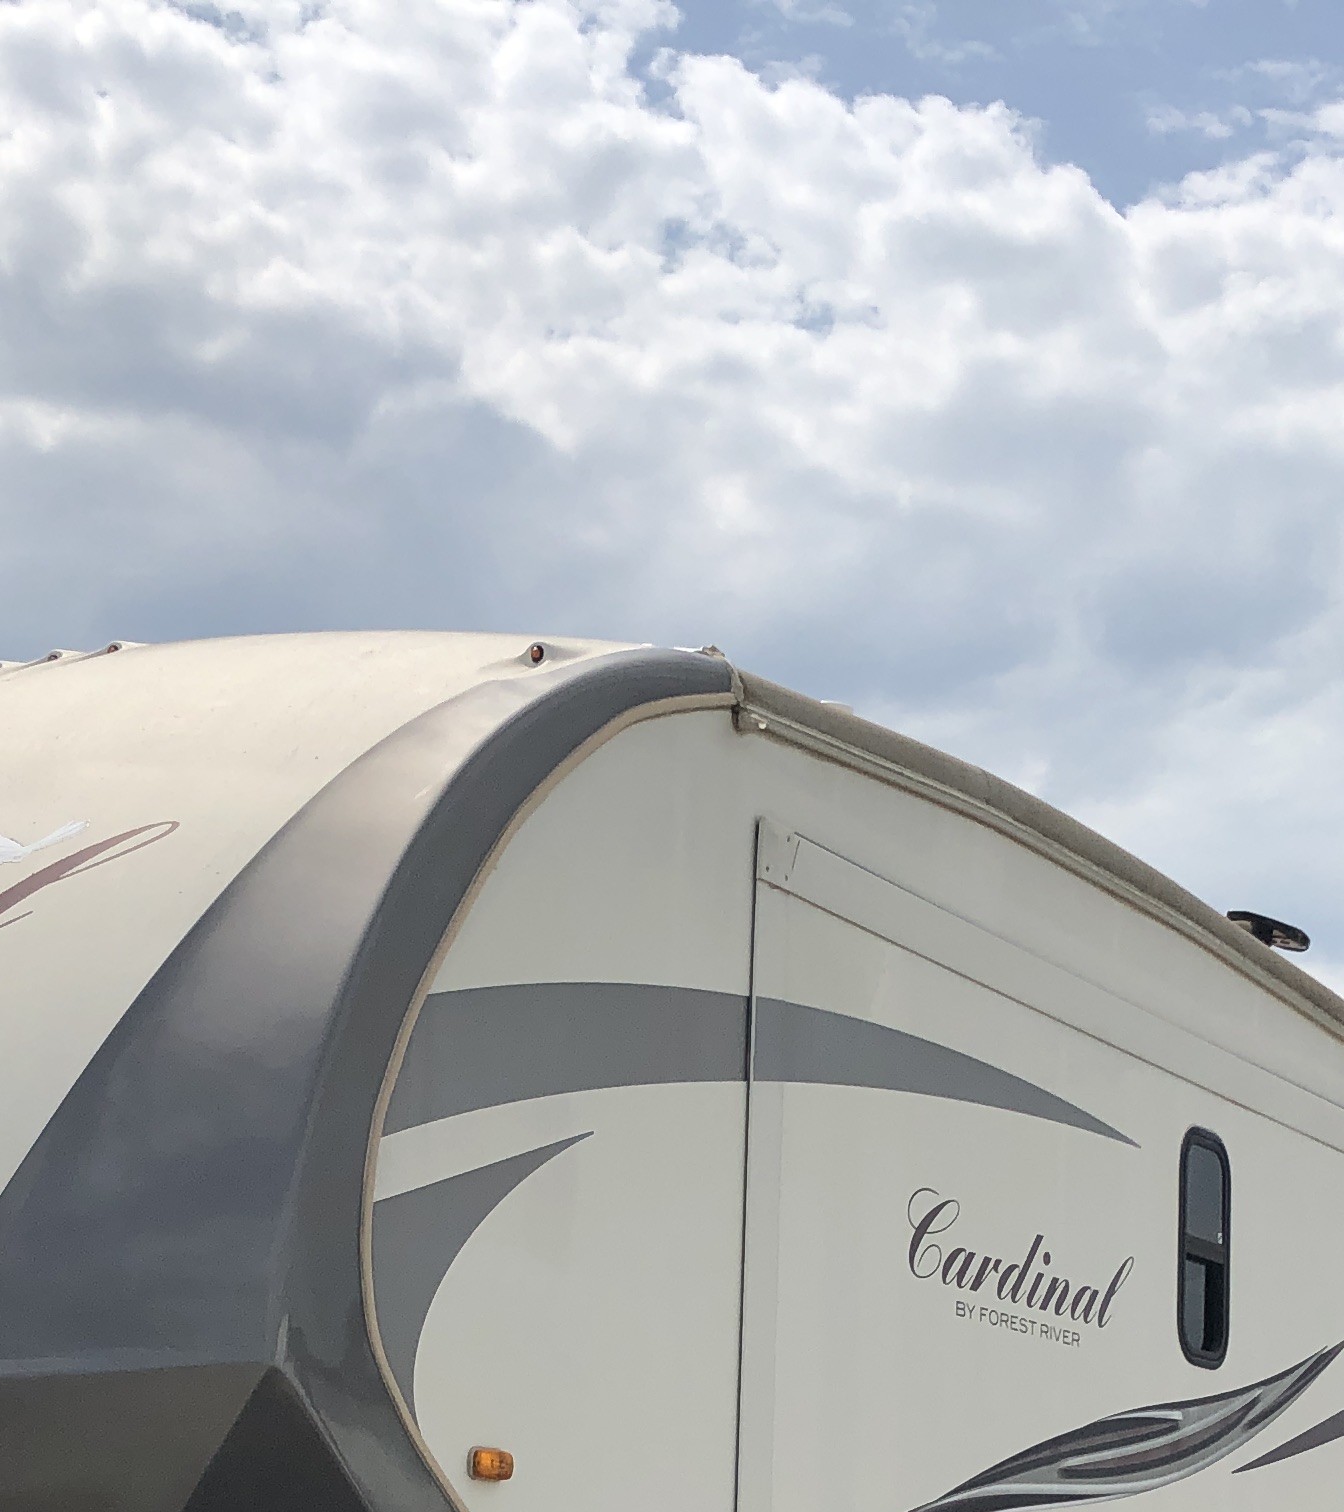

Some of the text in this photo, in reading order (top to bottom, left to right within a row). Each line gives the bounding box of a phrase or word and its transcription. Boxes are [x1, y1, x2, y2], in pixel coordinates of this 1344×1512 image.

[907, 1187, 1135, 1329] Cardinal
[955, 1300, 1081, 1348] BY FOREST RIVER
